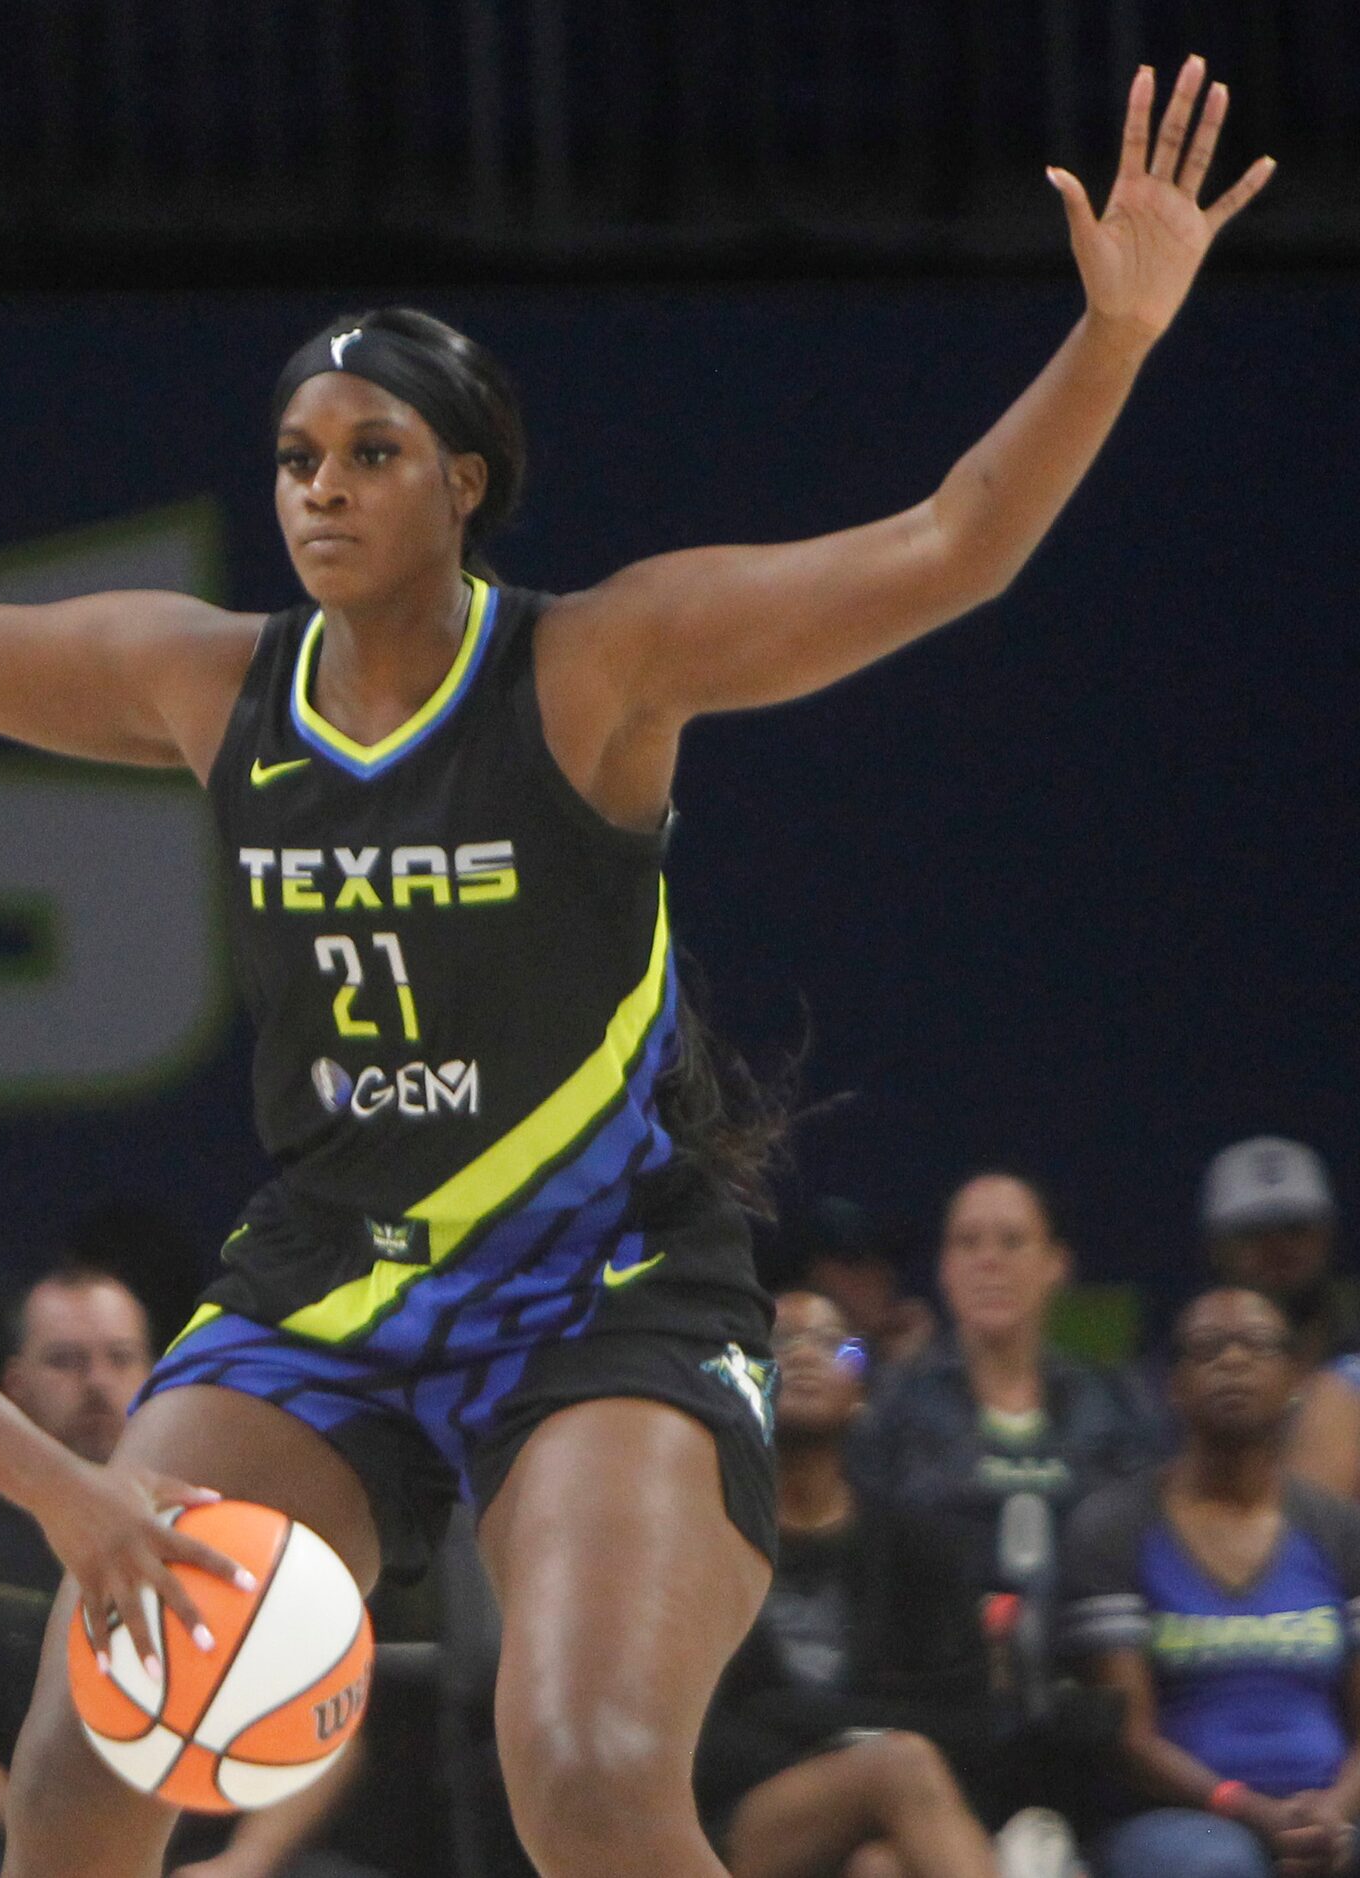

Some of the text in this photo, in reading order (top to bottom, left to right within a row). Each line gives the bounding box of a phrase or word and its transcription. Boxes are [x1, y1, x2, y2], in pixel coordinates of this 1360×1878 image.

[240, 840, 519, 910] TEXAS
[313, 932, 421, 1040] 21
[350, 1060, 478, 1116] GEM
